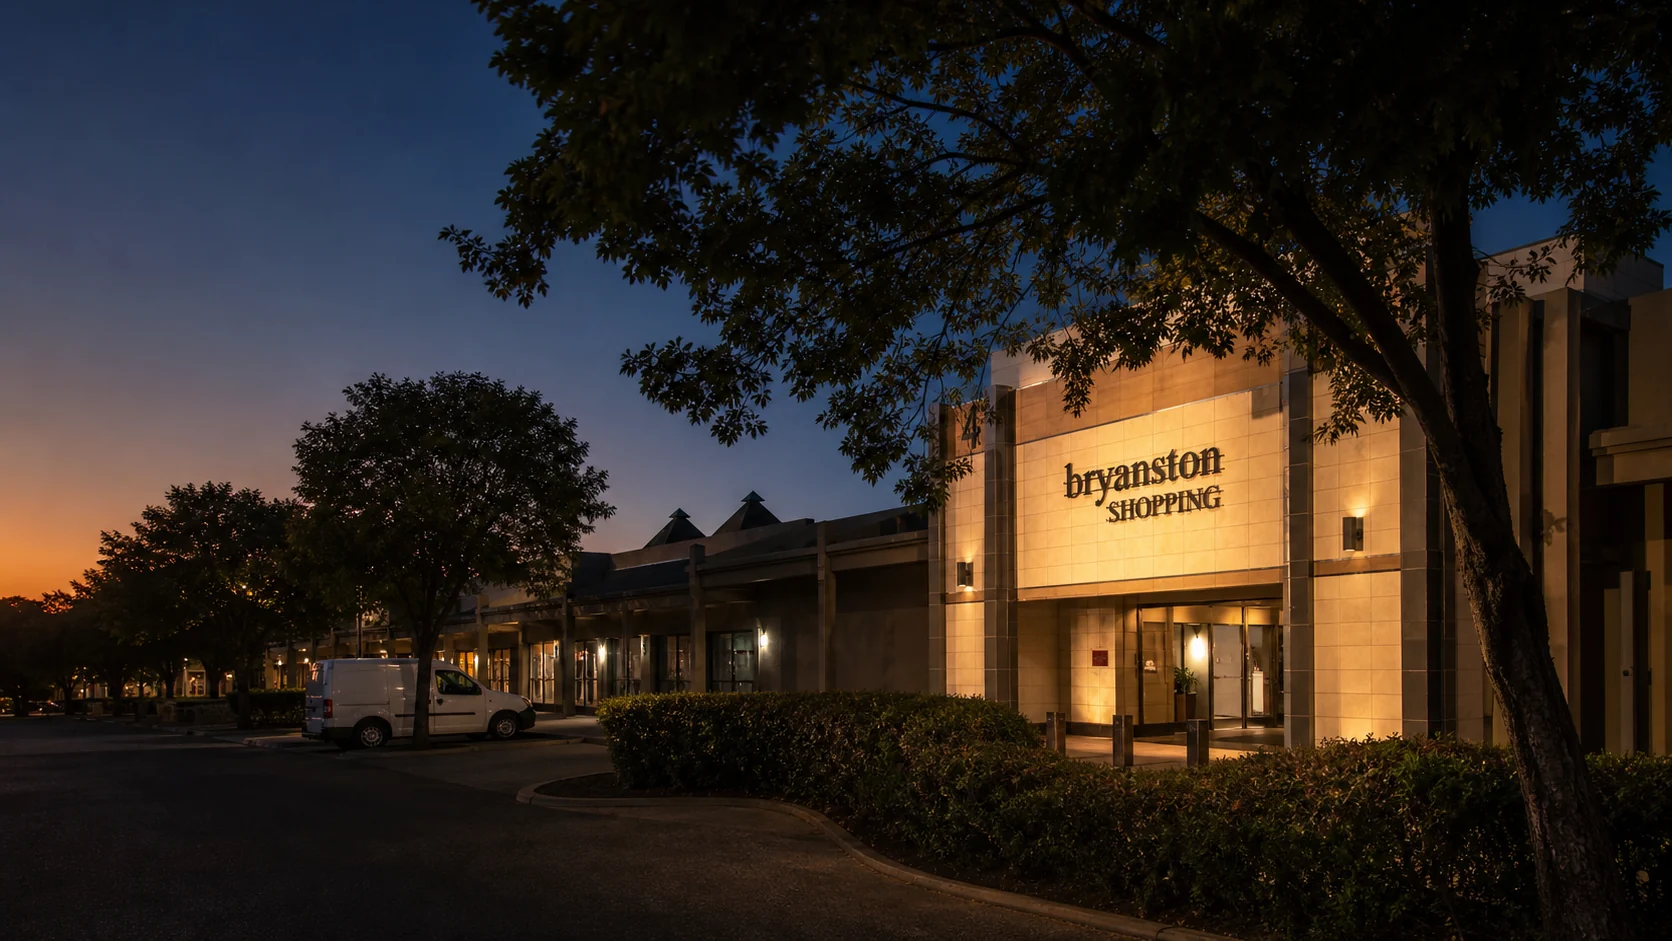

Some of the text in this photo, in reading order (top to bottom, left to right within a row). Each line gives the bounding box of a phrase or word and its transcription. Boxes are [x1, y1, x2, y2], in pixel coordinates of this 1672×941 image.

[962, 403, 981, 449] 4
[1064, 446, 1222, 506] bryanston
[1107, 485, 1222, 522] SHOPPING
